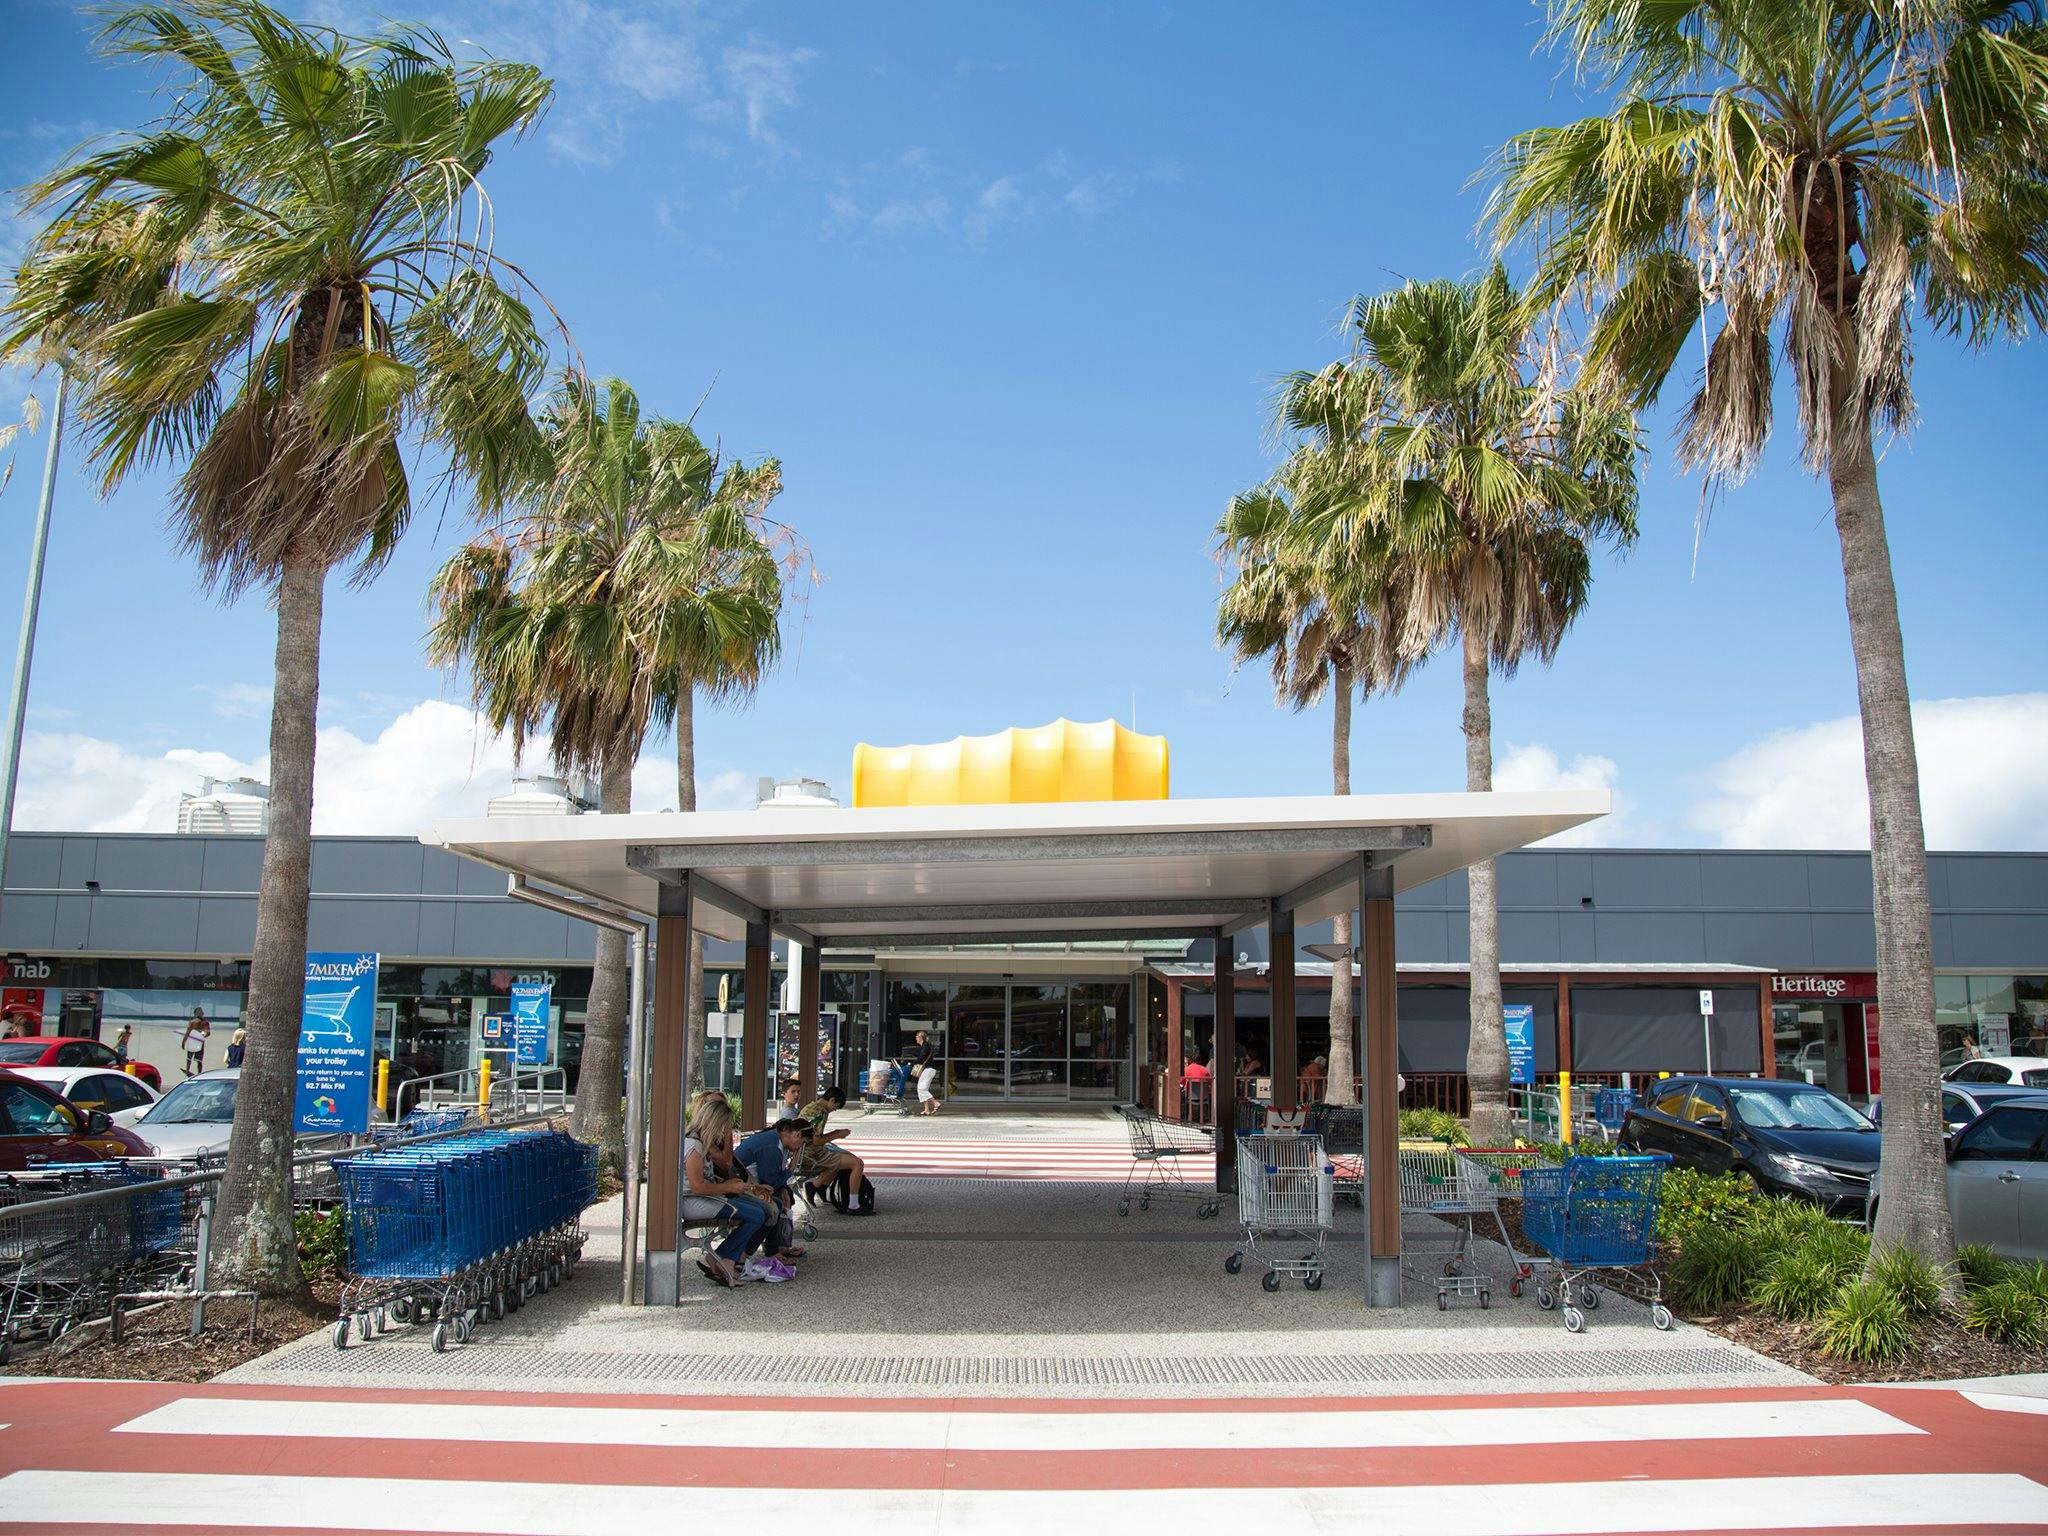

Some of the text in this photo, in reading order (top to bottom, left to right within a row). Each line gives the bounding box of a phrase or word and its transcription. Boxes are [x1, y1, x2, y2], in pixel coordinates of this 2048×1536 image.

[14, 961, 51, 979] nab
[306, 963, 359, 976] .7MIXFM
[517, 970, 556, 988] nab
[1771, 976, 1846, 997] Heritage
[331, 1048, 364, 1056] returning
[324, 1058, 348, 1066] trolley
